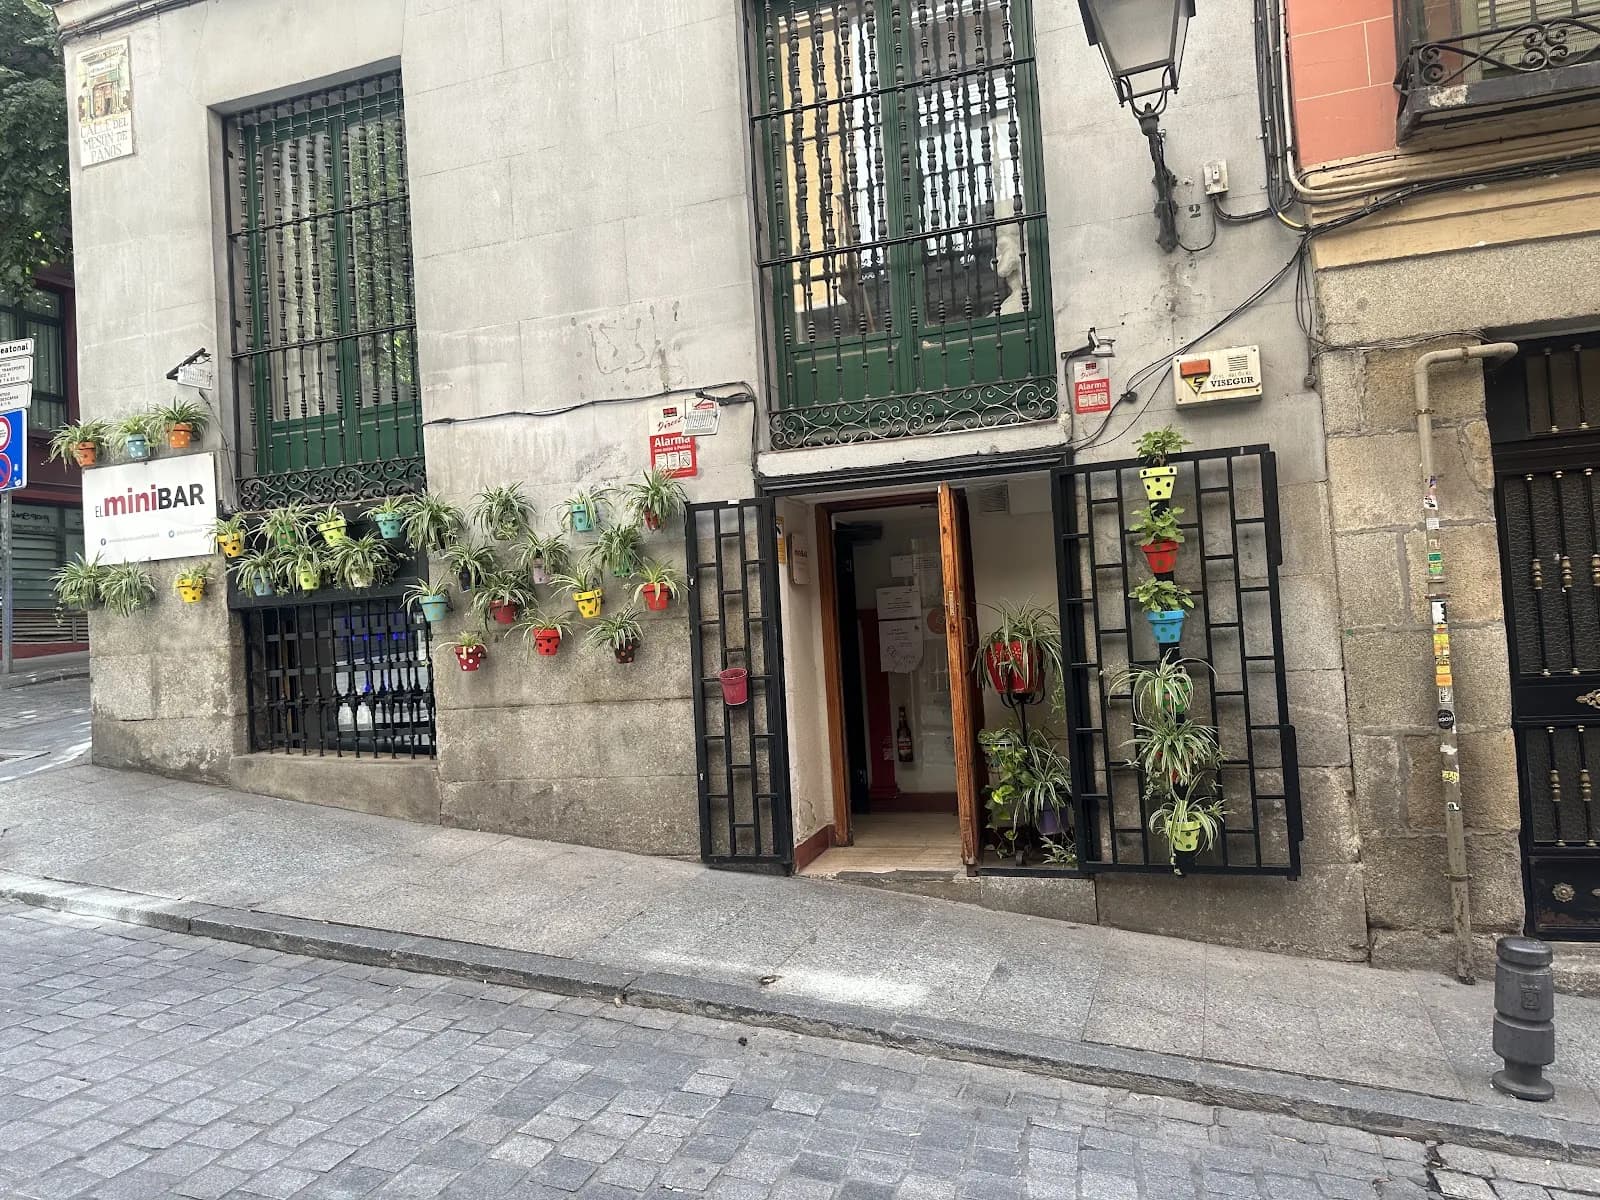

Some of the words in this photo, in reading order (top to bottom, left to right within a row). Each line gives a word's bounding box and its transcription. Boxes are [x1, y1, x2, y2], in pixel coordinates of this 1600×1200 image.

[113, 117, 129, 129] DEL
[0, 343, 28, 353] eatonal
[1078, 382, 1107, 390] Alarma
[1210, 376, 1254, 387] VISEGUR
[654, 436, 691, 448] Alarma
